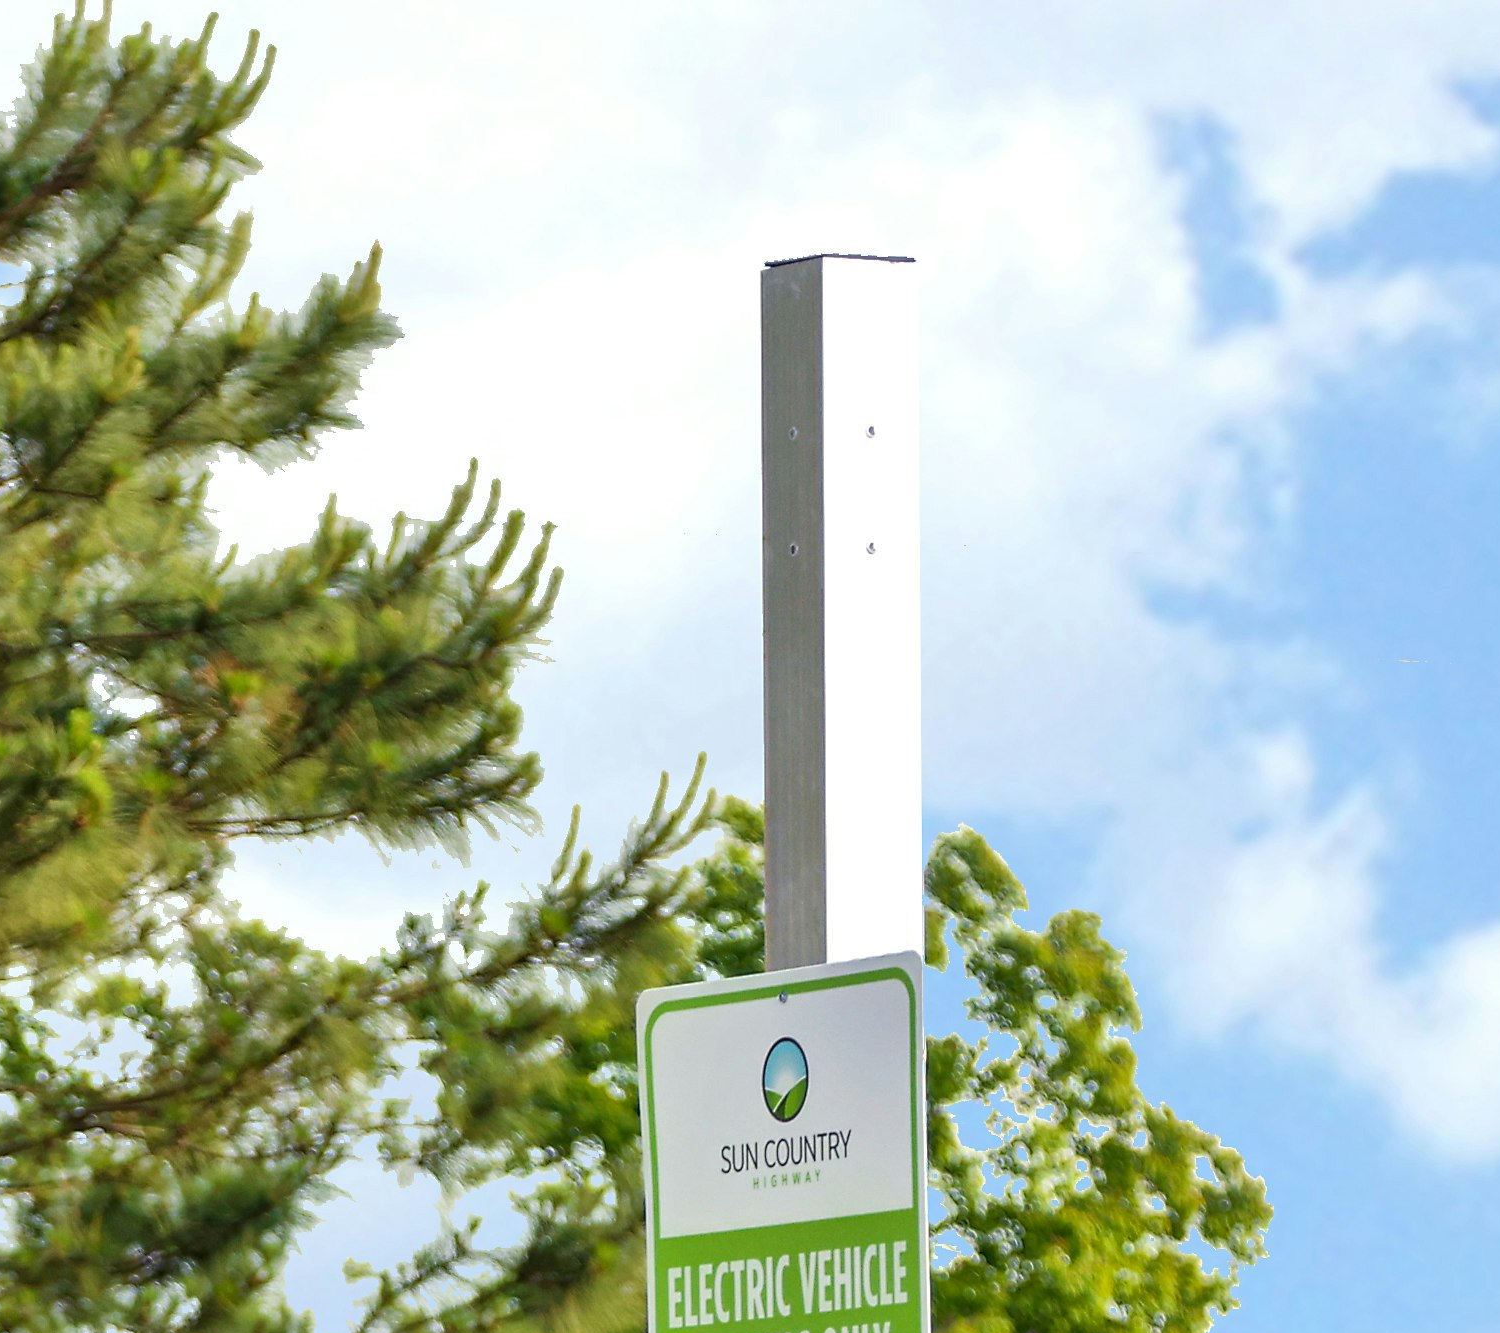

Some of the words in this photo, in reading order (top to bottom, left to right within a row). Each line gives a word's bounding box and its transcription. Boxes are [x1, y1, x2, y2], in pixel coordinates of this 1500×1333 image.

[721, 1142, 758, 1174] SUN
[764, 1129, 852, 1168] COUNTRY
[753, 1169, 821, 1189] HIGHWAY
[667, 1254, 791, 1329] ELECTRIC
[798, 1240, 908, 1314] VEHICLE
